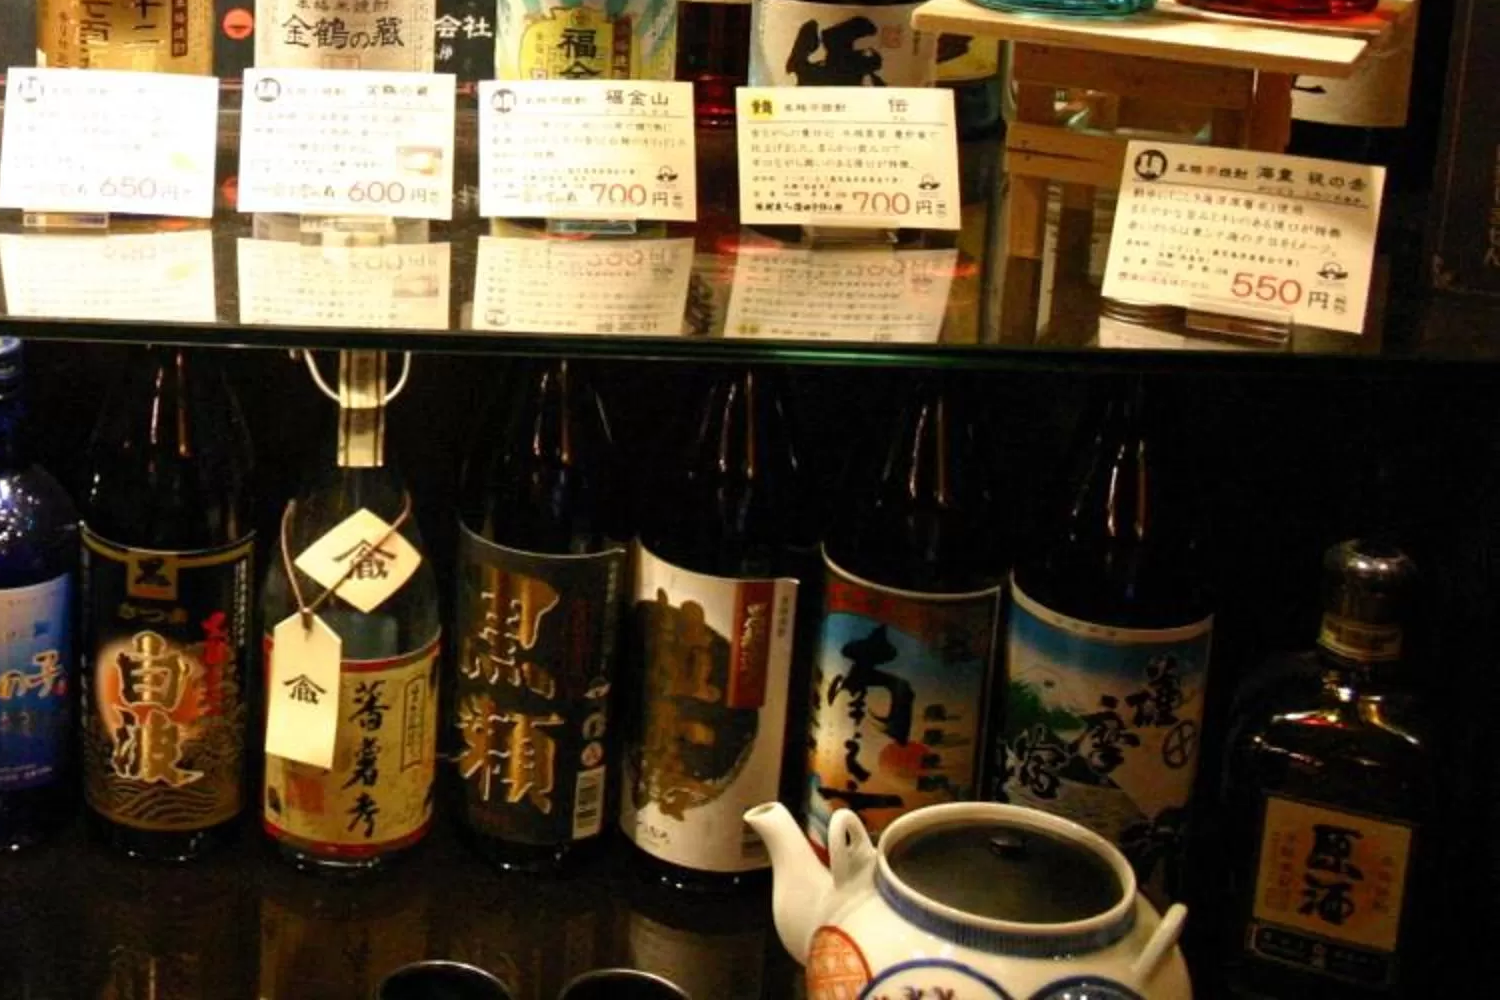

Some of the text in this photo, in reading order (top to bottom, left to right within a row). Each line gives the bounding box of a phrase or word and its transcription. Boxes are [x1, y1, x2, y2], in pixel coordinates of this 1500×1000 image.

[280, 14, 405, 49] 金鶴の蔵
[434, 14, 493, 40] 会社
